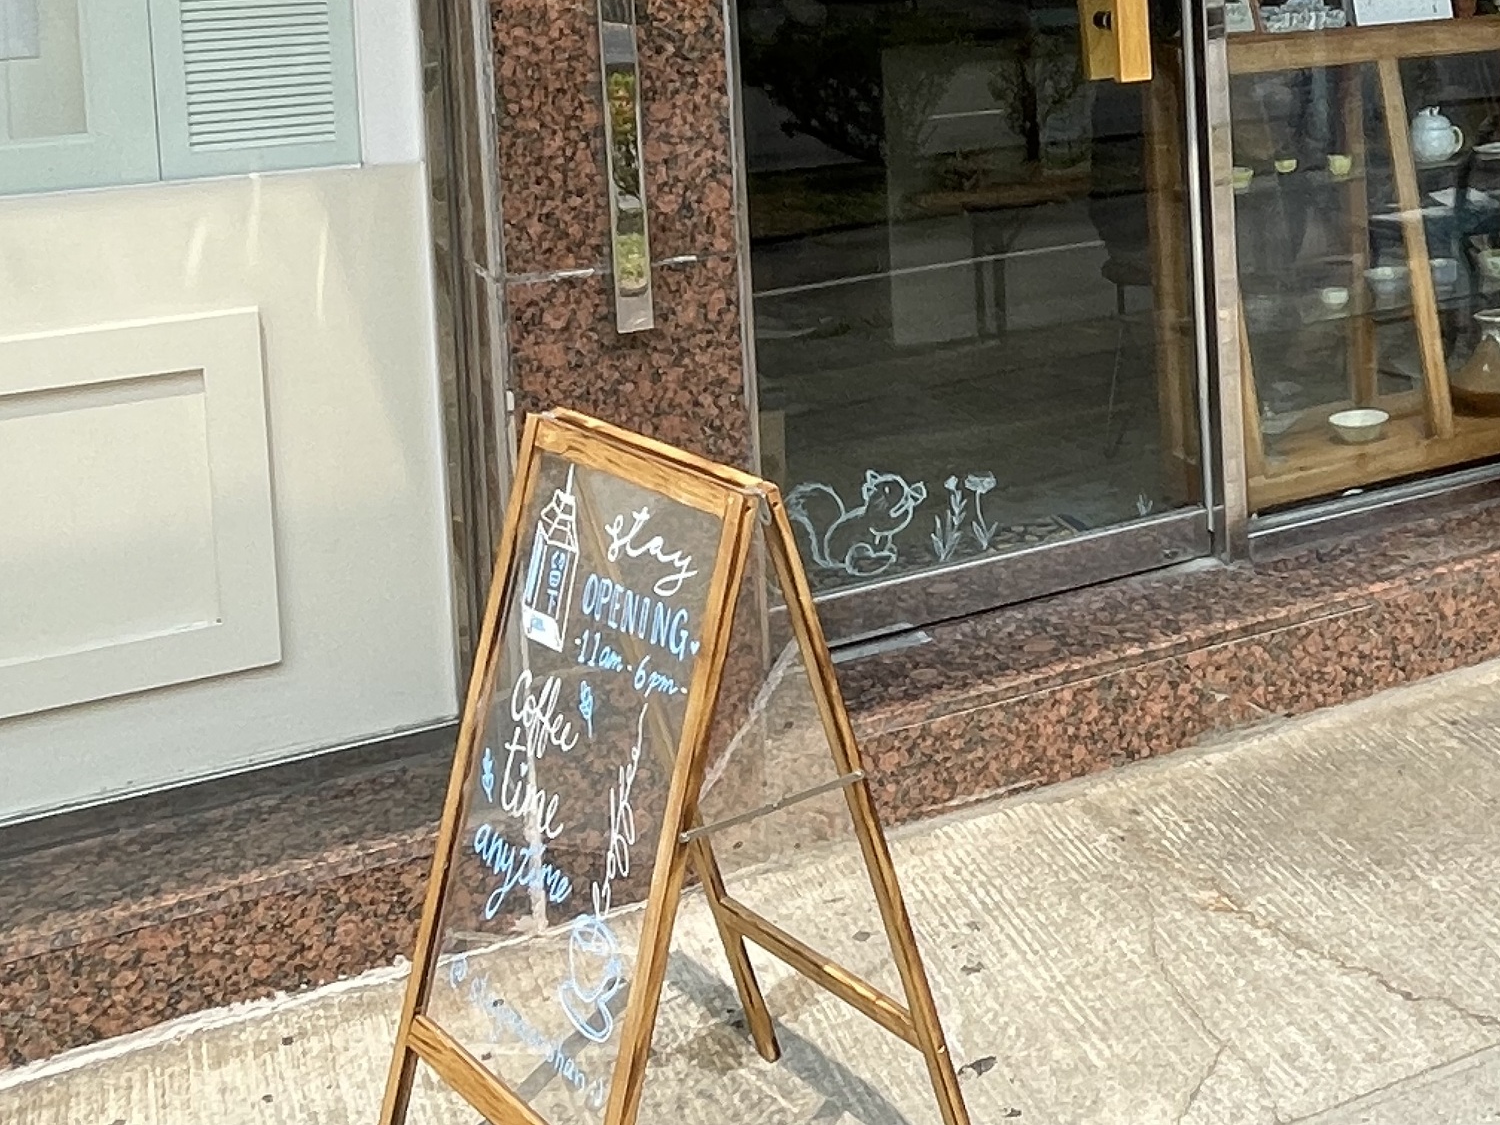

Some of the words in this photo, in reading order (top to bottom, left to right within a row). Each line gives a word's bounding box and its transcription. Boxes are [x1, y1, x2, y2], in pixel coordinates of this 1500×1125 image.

[582, 574, 689, 662] OPENING
[501, 727, 564, 839] time
[474, 823, 573, 919] anytime
